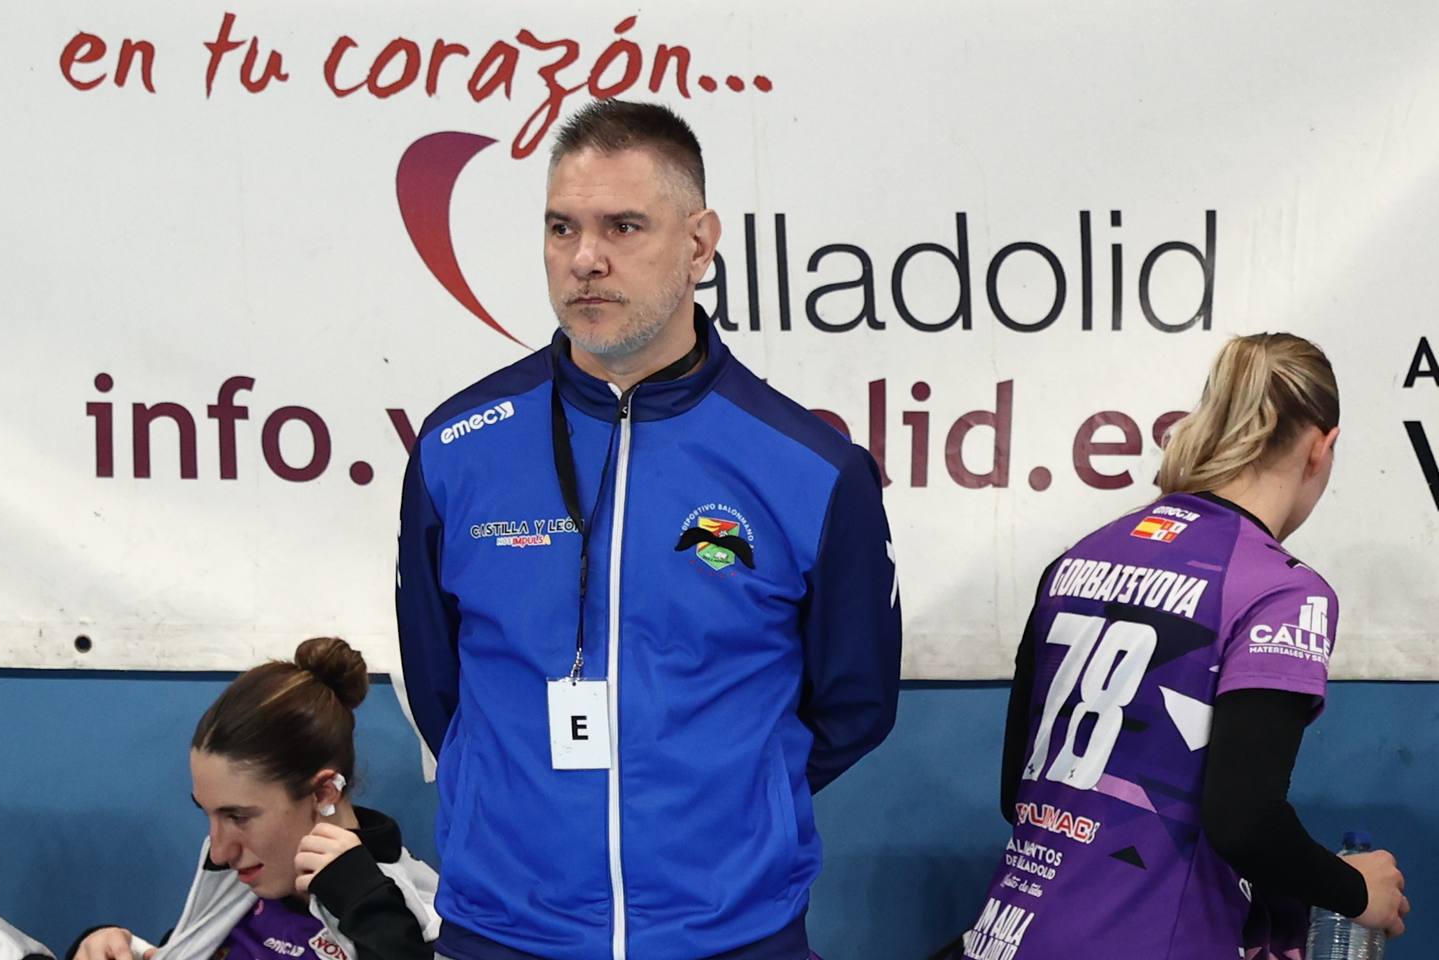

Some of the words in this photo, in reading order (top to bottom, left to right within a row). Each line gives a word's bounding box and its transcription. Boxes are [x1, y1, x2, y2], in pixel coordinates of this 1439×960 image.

[60, 32, 155, 94] en
[204, 12, 288, 98] tu
[323, 15, 773, 160] corazón...
[696, 210, 1217, 333] alladolid
[534, 520, 545, 534] Y
[571, 715, 589, 740] E
[1022, 612, 1158, 790] 78
